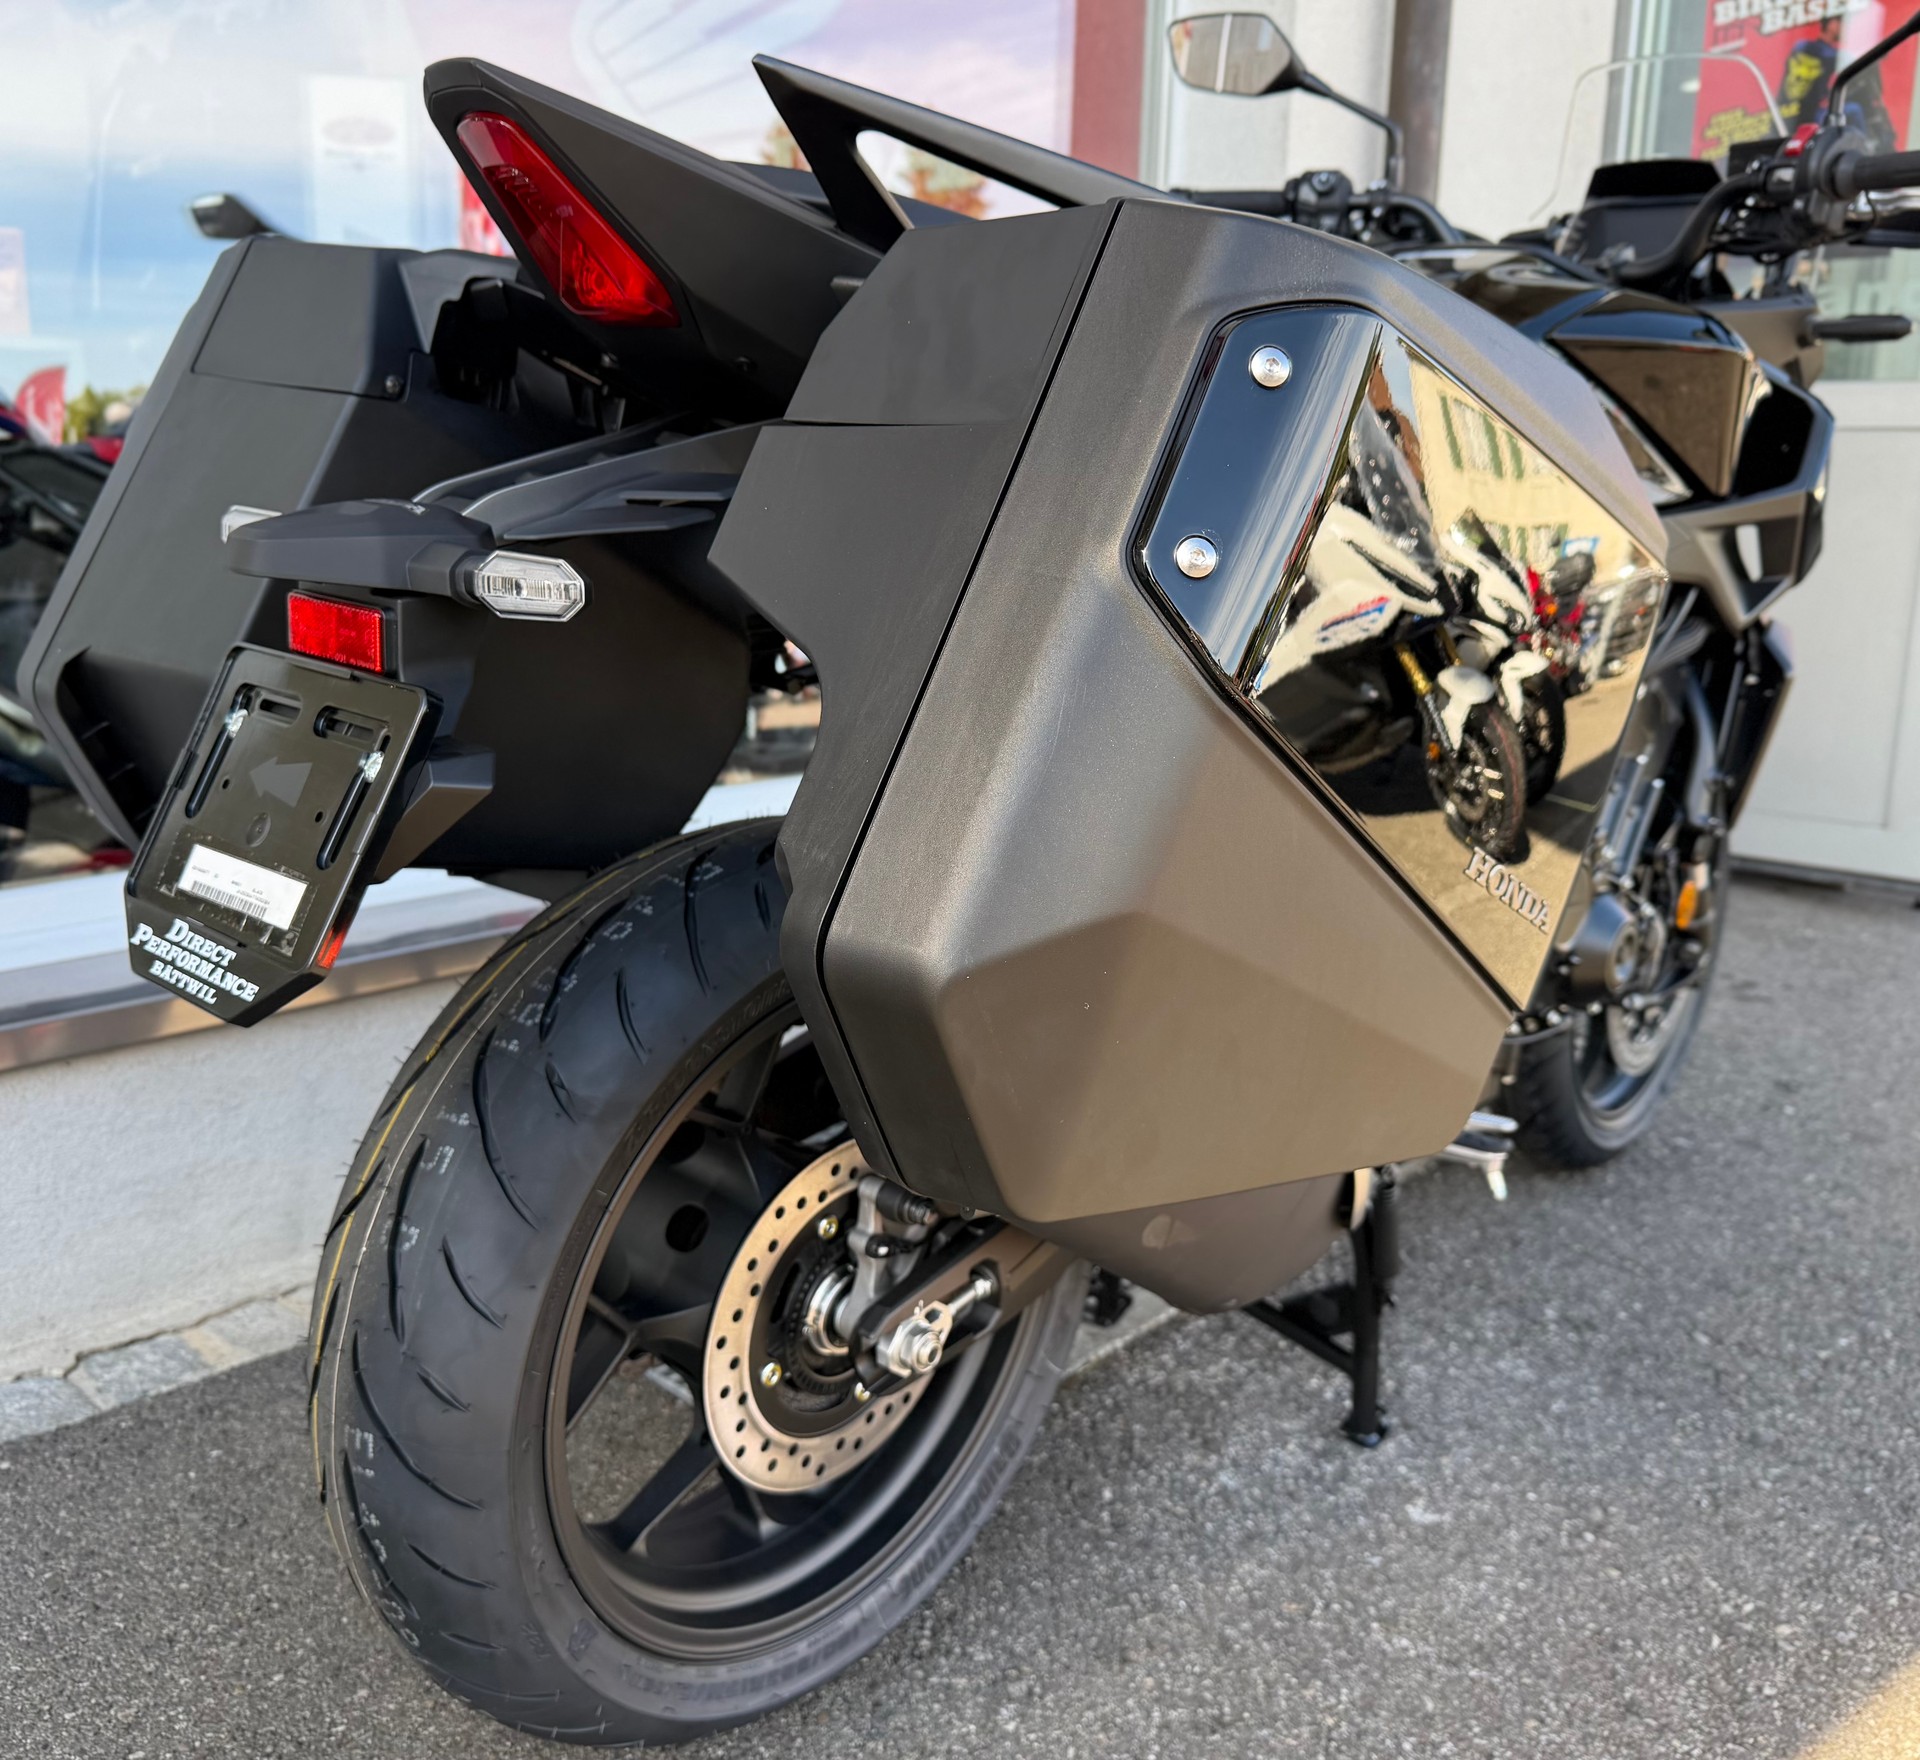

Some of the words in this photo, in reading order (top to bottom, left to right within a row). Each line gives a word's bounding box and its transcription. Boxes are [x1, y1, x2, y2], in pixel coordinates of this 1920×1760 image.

[1760, 0, 1870, 36] BASEL
[1463, 846, 1550, 934] HONDA
[130, 922, 260, 1003] PERFORMANCE
[164, 918, 237, 967] DIRECT
